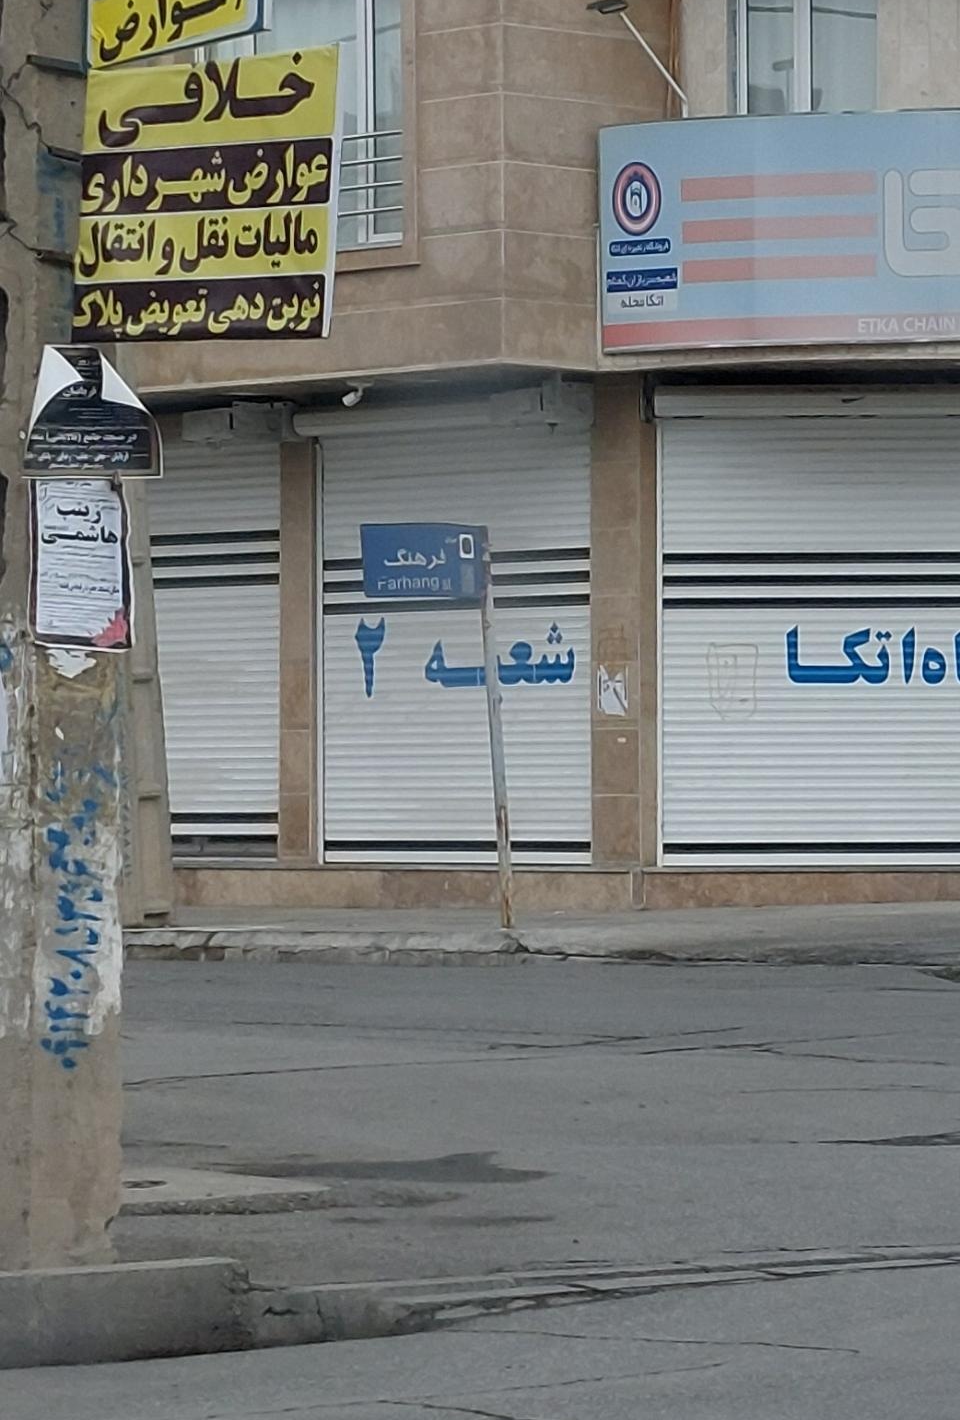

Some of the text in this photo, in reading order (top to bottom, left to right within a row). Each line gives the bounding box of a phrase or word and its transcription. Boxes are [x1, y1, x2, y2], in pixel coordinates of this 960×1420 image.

[98, 51, 317, 148] خلافی
[80, 144, 329, 213] عوارض شهرداری
[78, 210, 318, 278] مالیات نقل و انتقال
[72, 281, 321, 339] نوبت دهی تعویض پلاک
[857, 317, 899, 334] ETKA
[903, 315, 954, 332] CHAIN
[41, 525, 119, 545] هاشمی
[377, 576, 440, 591] Farhang
[355, 617, 386, 698] ۲
[785, 624, 916, 687] اتکا
